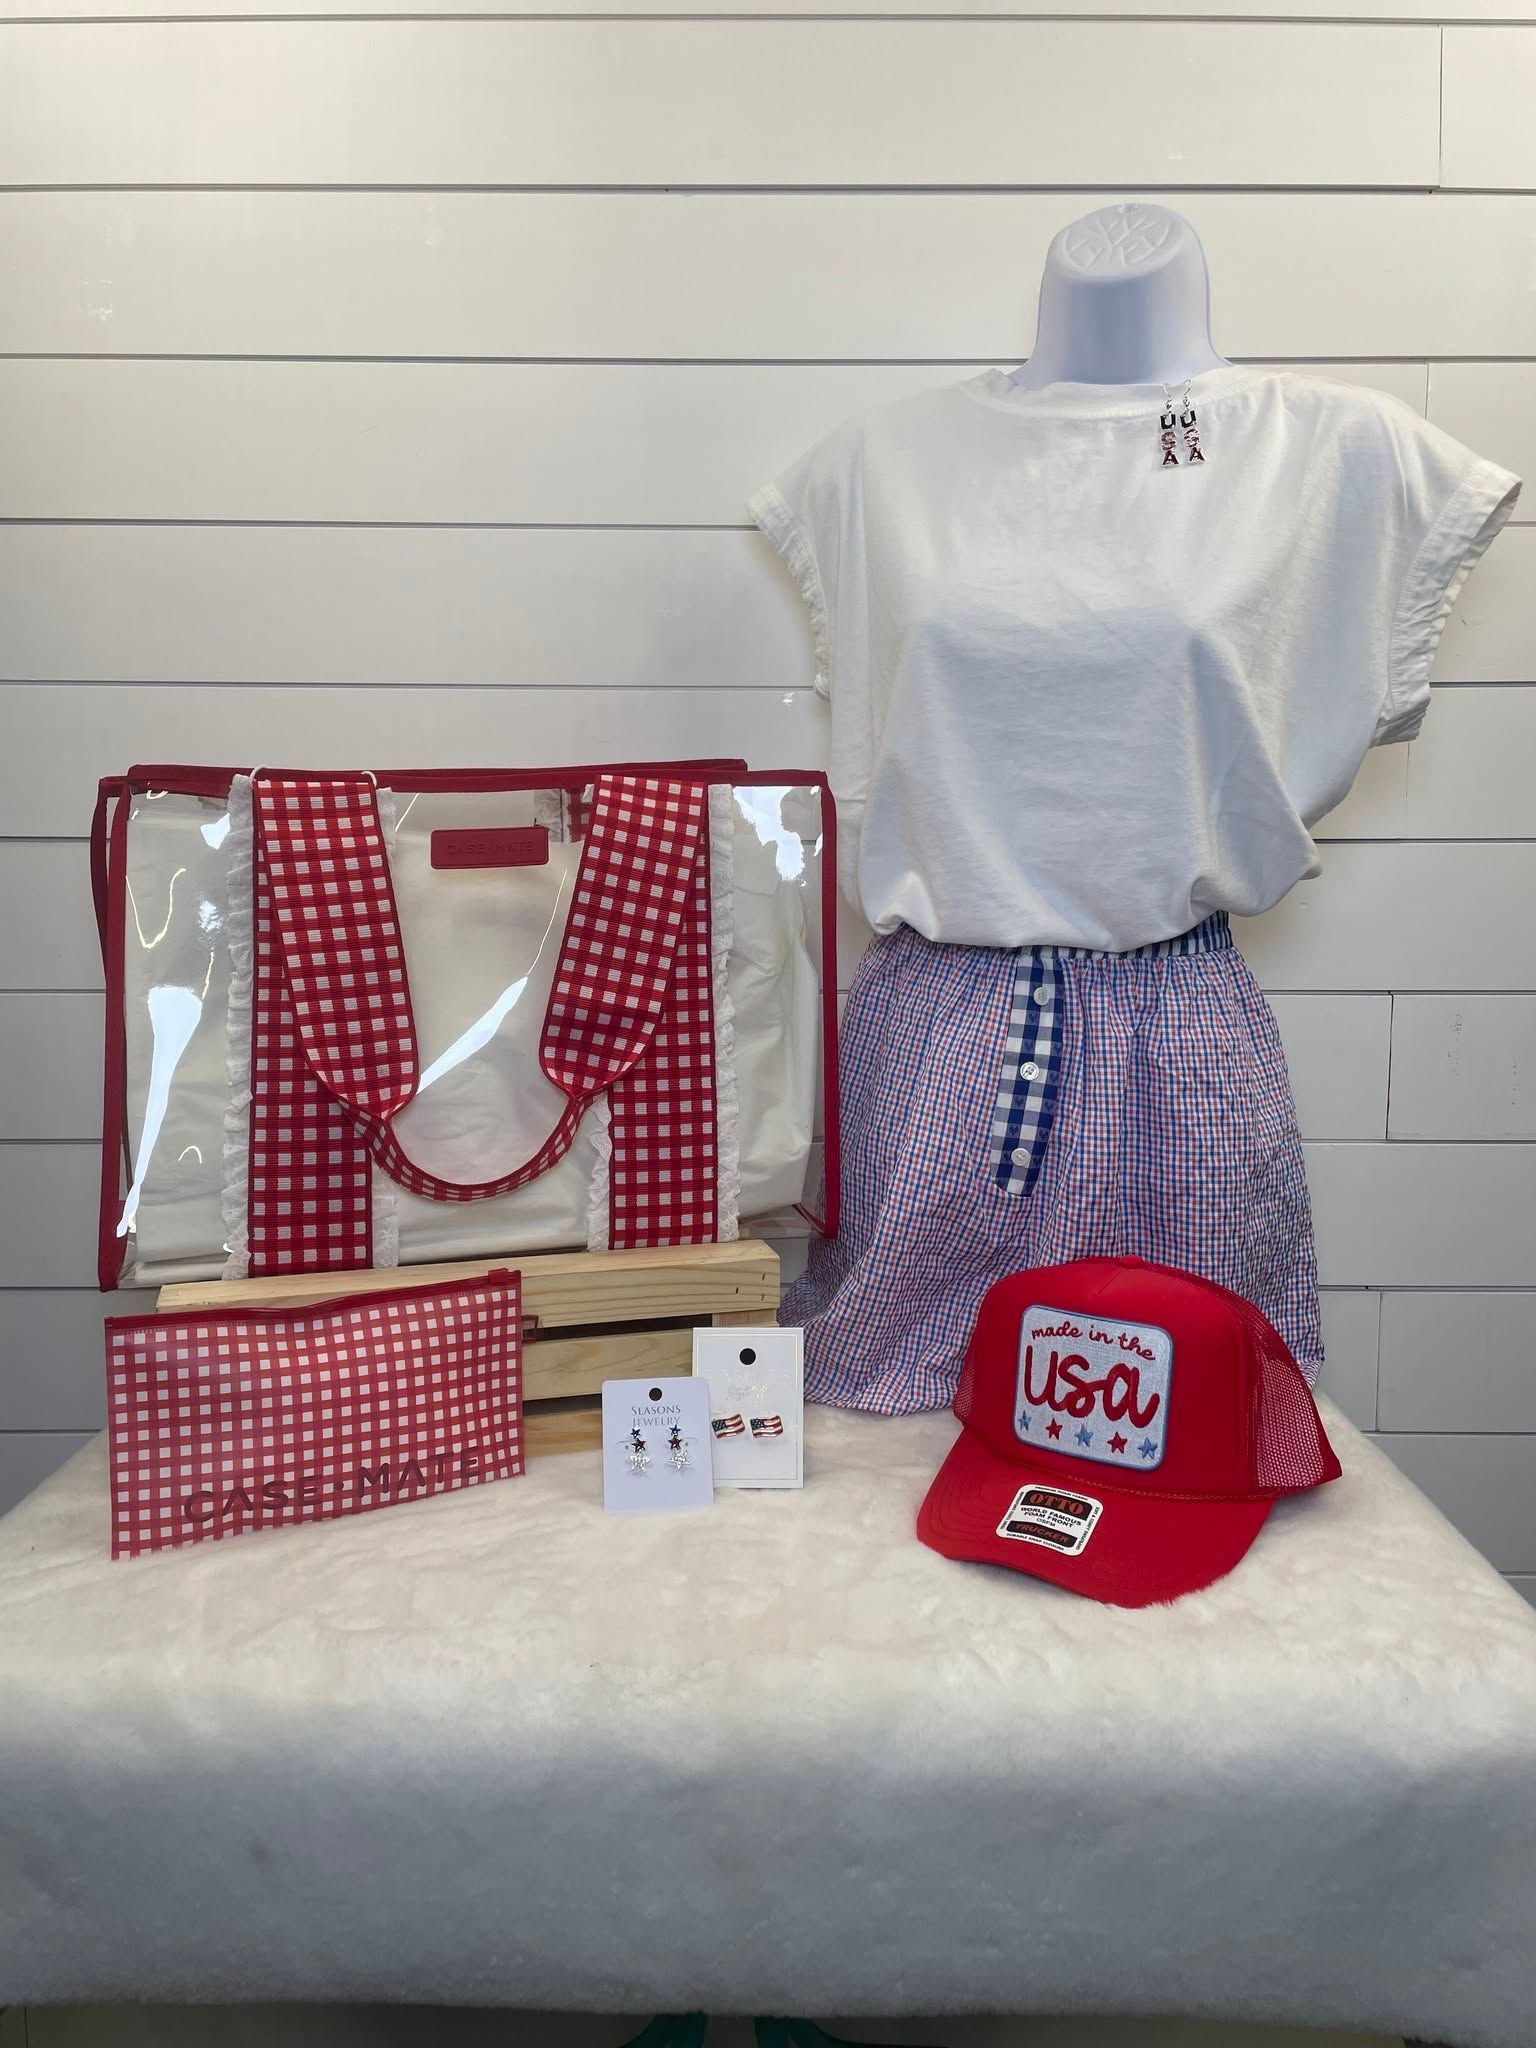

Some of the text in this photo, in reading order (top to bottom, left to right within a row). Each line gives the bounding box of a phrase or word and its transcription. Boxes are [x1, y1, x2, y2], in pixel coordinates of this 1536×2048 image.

[1031, 1321, 1156, 1361] made in the
[1029, 1493, 1084, 1515] OTTO
[1024, 1511, 1073, 1528] FOAM FRONT
[1049, 1511, 1081, 1526] FAMOUS
[1015, 1523, 1069, 1543] TRUCKER
